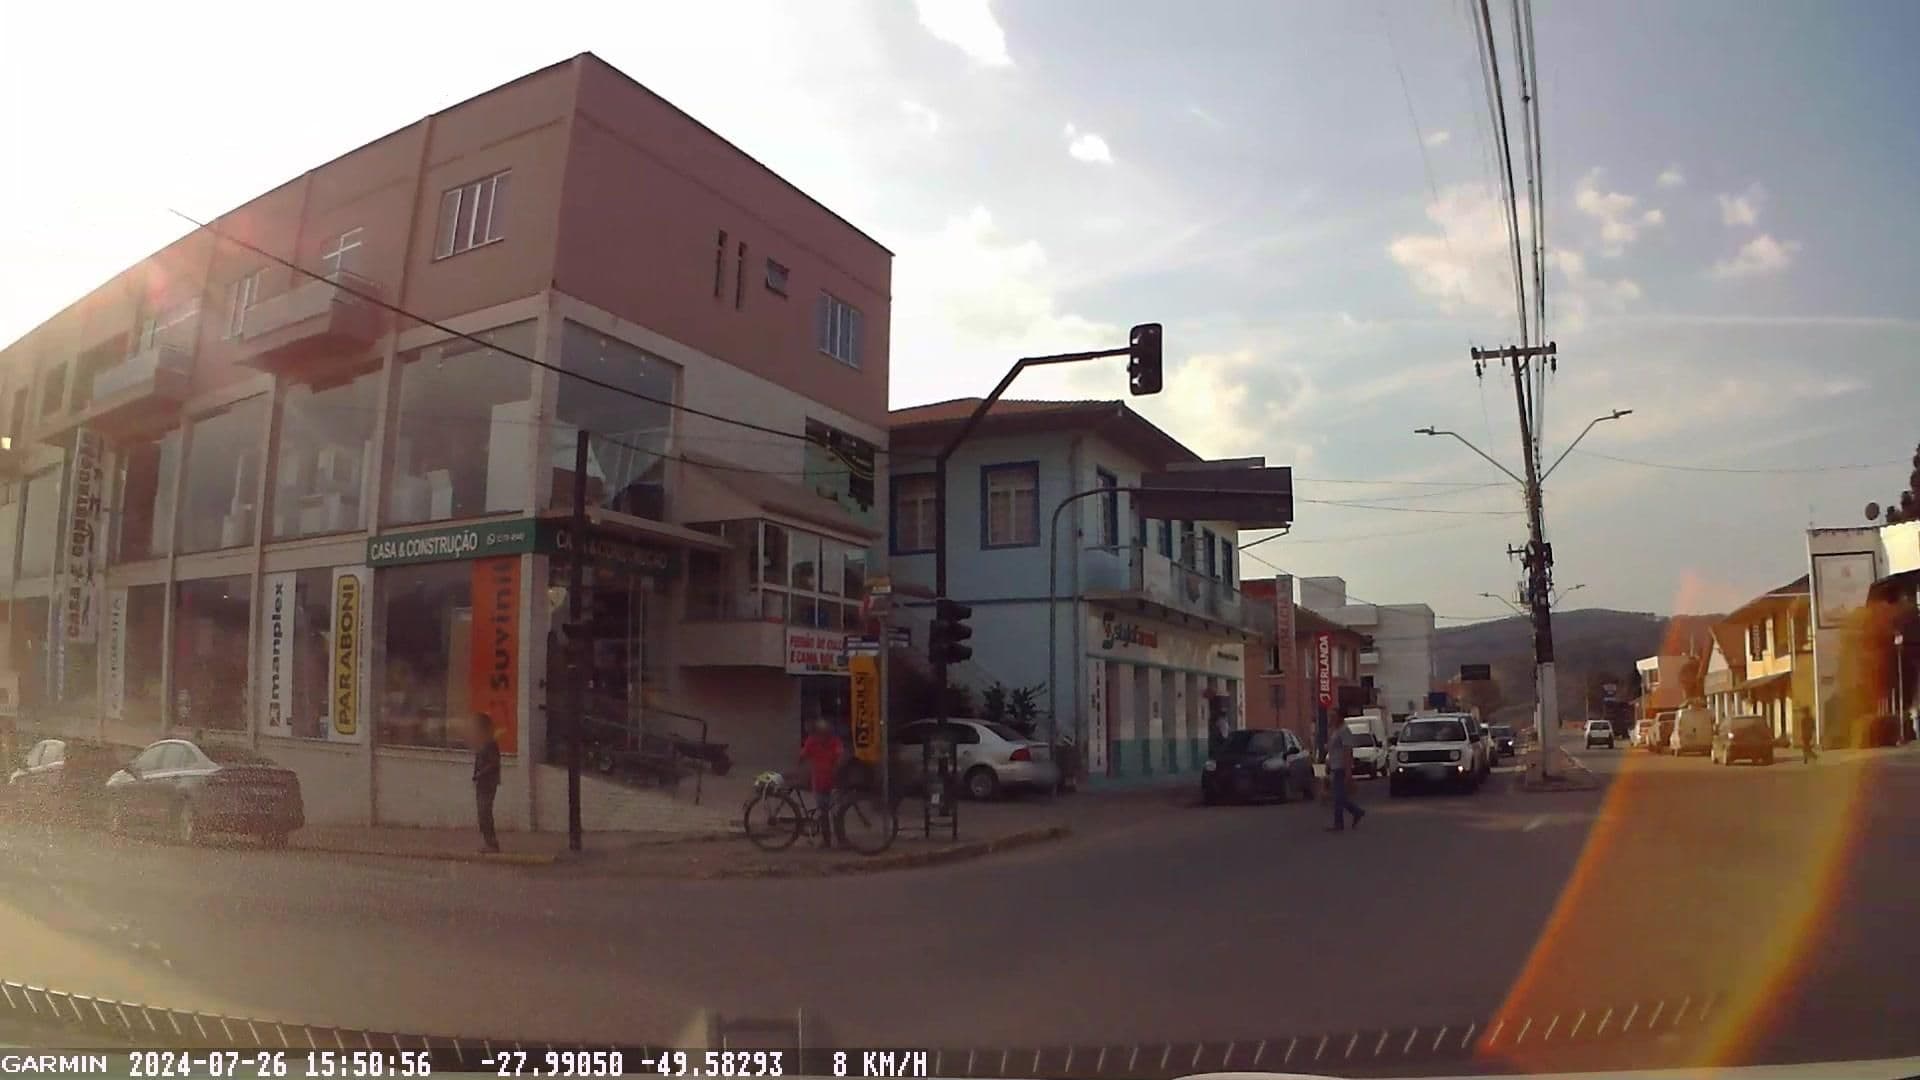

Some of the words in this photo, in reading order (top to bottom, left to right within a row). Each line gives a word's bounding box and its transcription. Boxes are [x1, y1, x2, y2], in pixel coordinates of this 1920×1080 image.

[372, 542, 397, 561] CASA
[399, 540, 406, 558] &
[407, 530, 478, 559] CONSTRUÇÃO
[271, 582, 284, 700] manplex
[339, 584, 354, 725] PARABONI
[1319, 635, 1330, 691] BERLANDA
